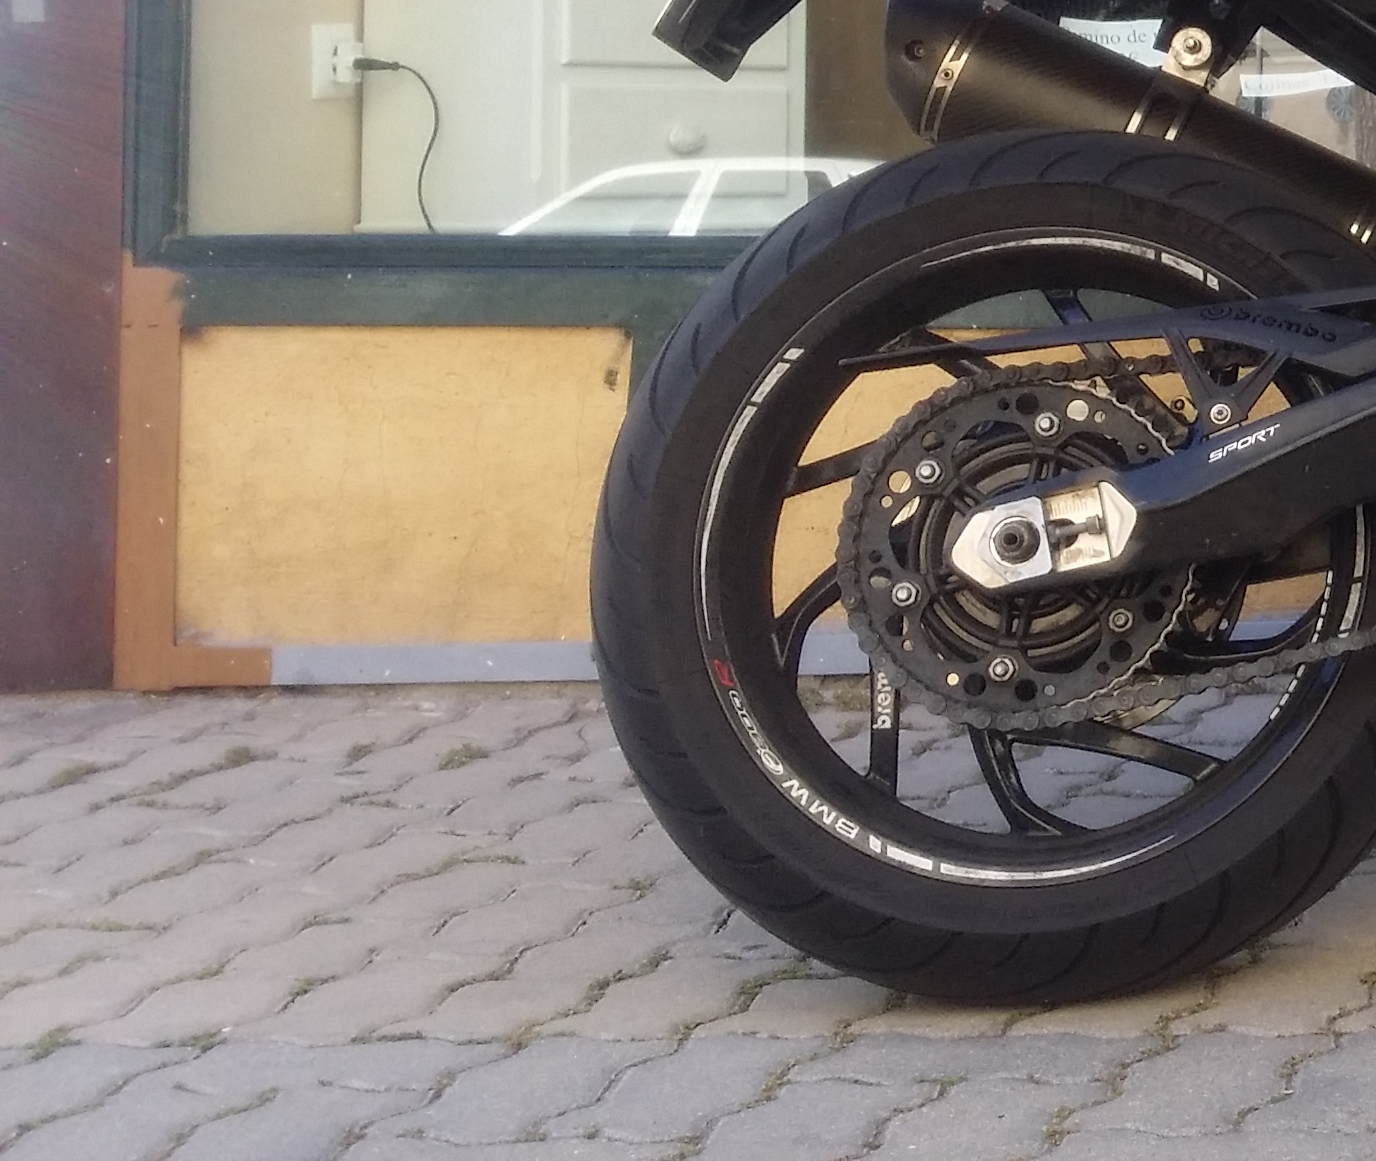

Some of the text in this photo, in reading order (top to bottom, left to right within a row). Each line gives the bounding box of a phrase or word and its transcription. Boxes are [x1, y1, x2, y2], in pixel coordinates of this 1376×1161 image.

[1126, 29, 1147, 43] de
[1207, 423, 1281, 464] SPORT
[782, 778, 860, 840] BMW
